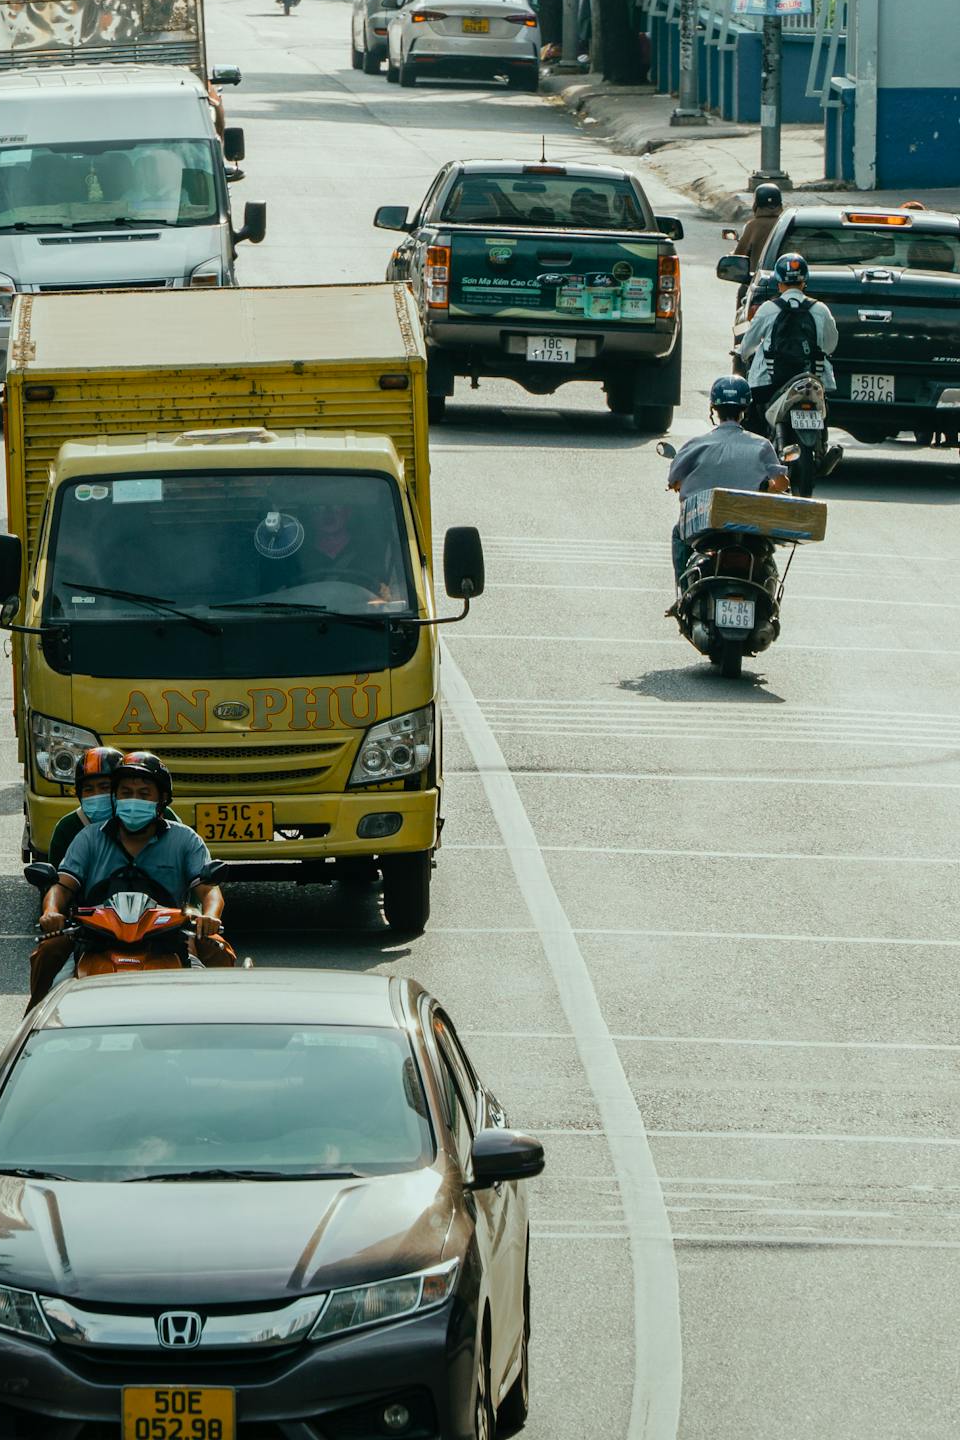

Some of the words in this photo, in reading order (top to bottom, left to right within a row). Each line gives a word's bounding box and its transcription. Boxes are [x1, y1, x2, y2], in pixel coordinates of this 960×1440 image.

[543, 338, 562, 350] 18C
[861, 375, 885, 390] 51C
[721, 614, 749, 626] 0496
[113, 689, 210, 734] AN
[247, 673, 381, 731] PHÚ
[217, 805, 251, 821] 51C
[204, 823, 264, 840] 374.41
[155, 1390, 202, 1415] 50E
[135, 1417, 223, 1440] 052.98
